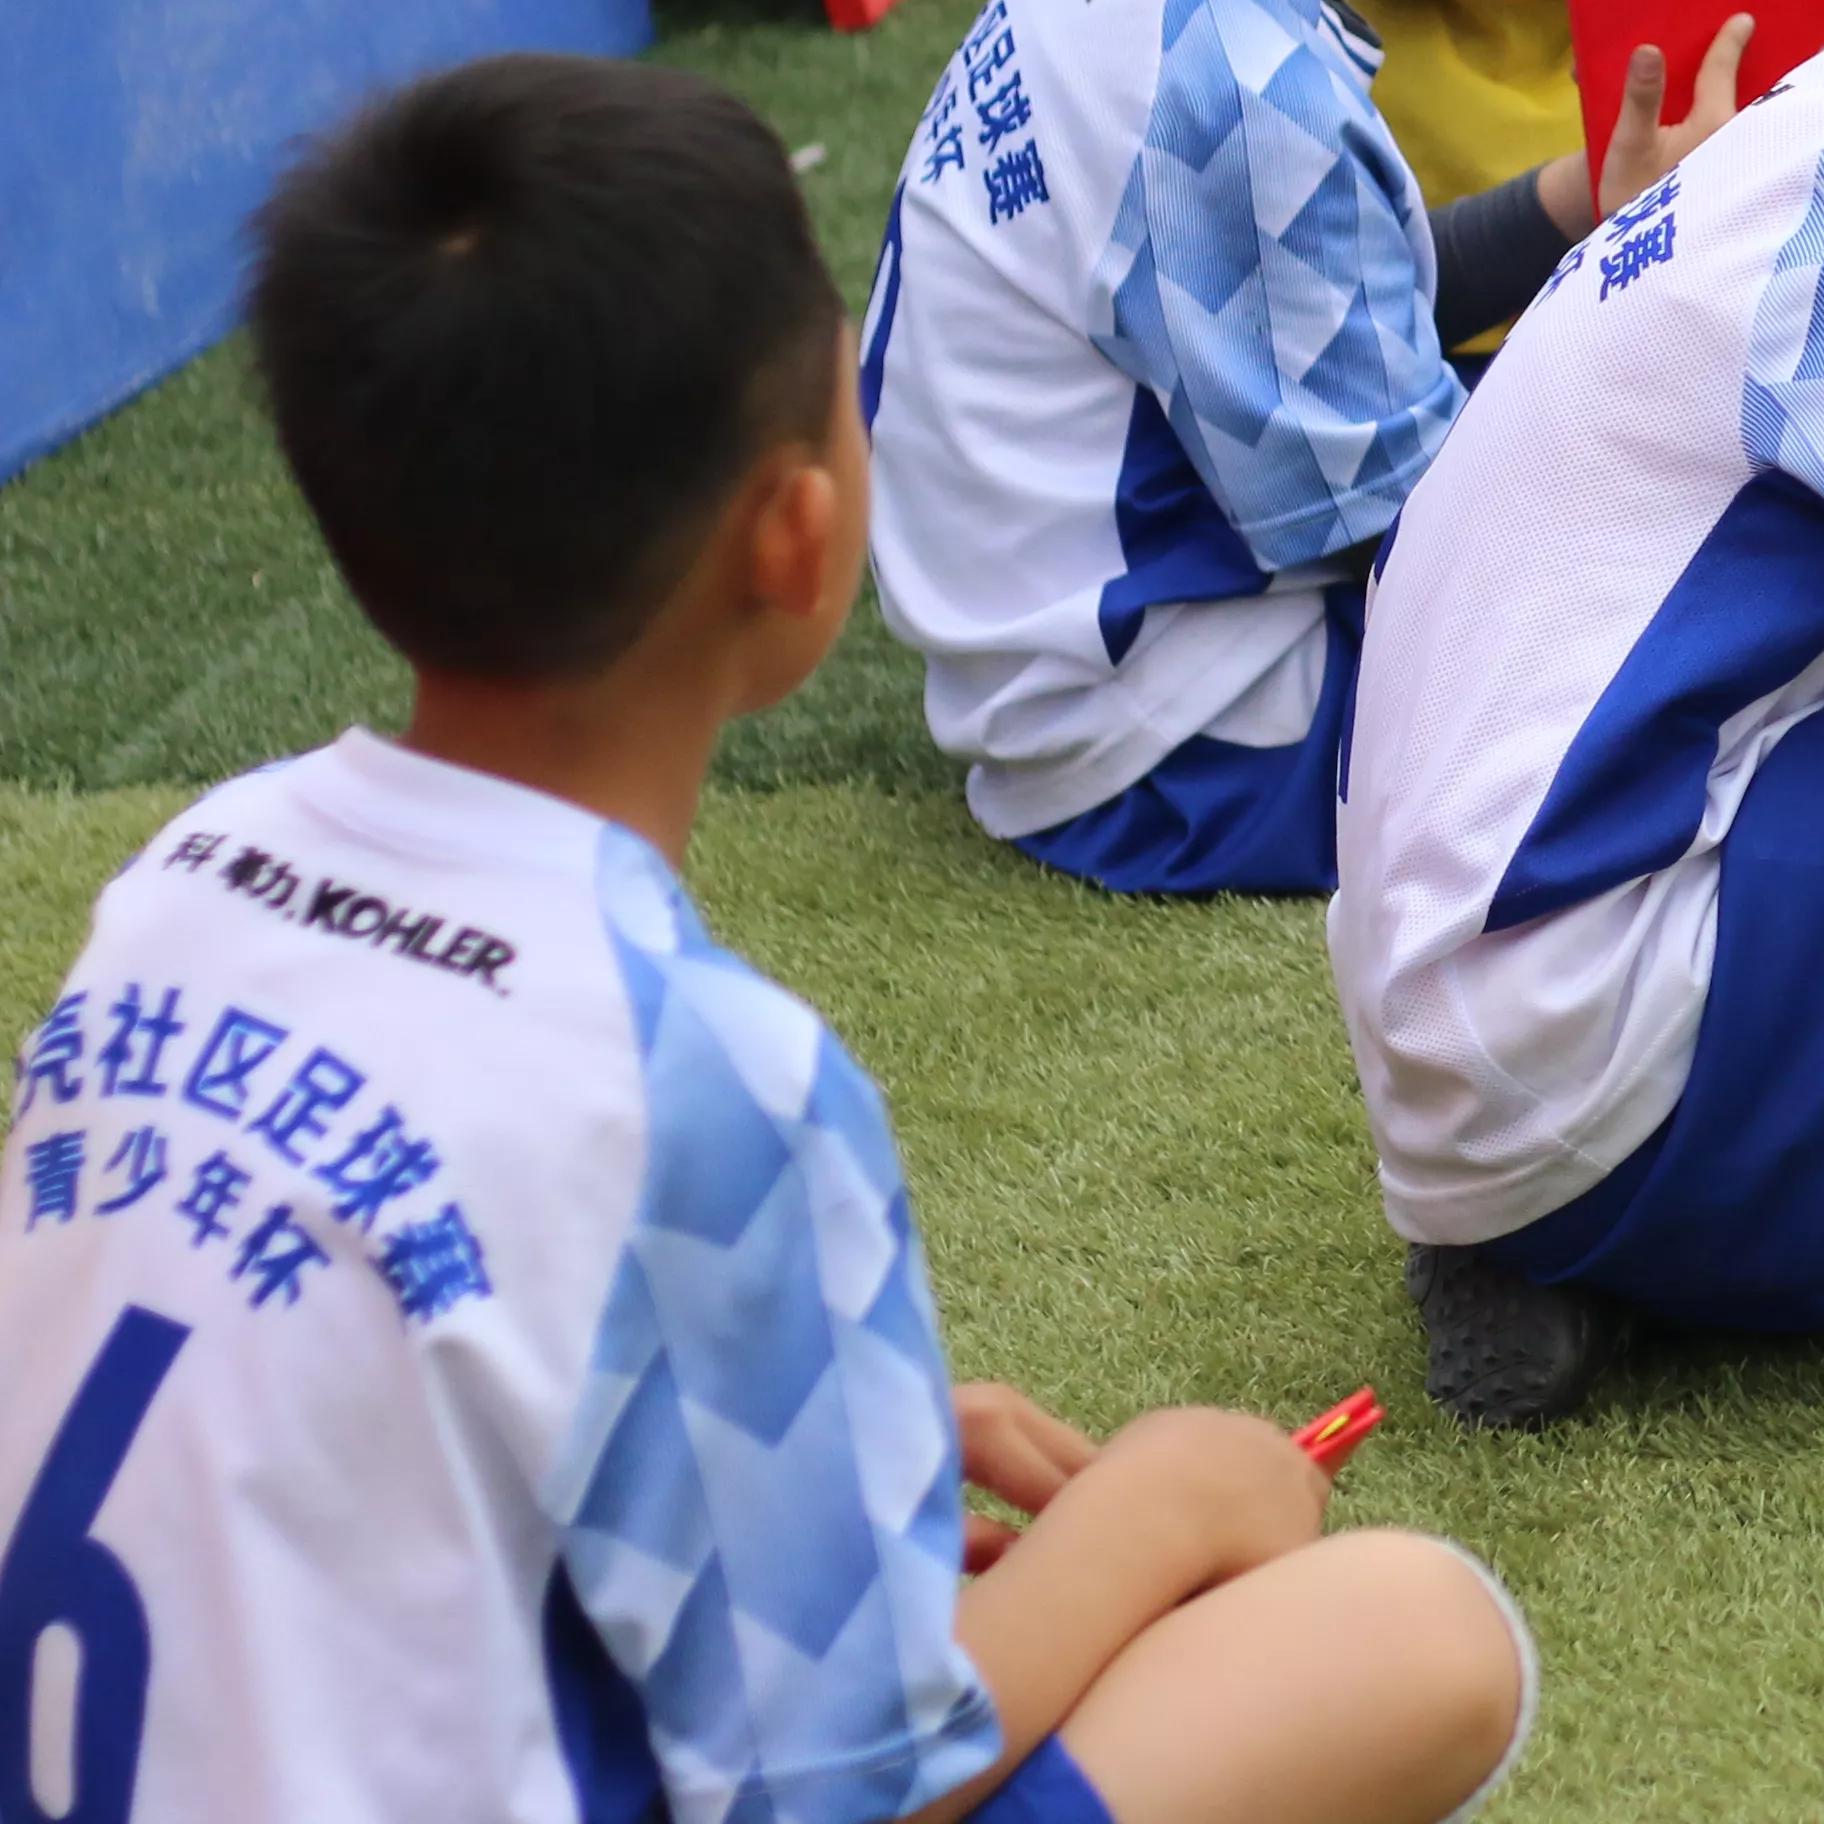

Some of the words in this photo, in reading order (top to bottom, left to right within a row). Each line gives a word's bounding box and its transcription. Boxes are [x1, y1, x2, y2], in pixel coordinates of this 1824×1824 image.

[23, 1126, 333, 1309] 青少年杯
[0, 1303, 194, 1824] 6
